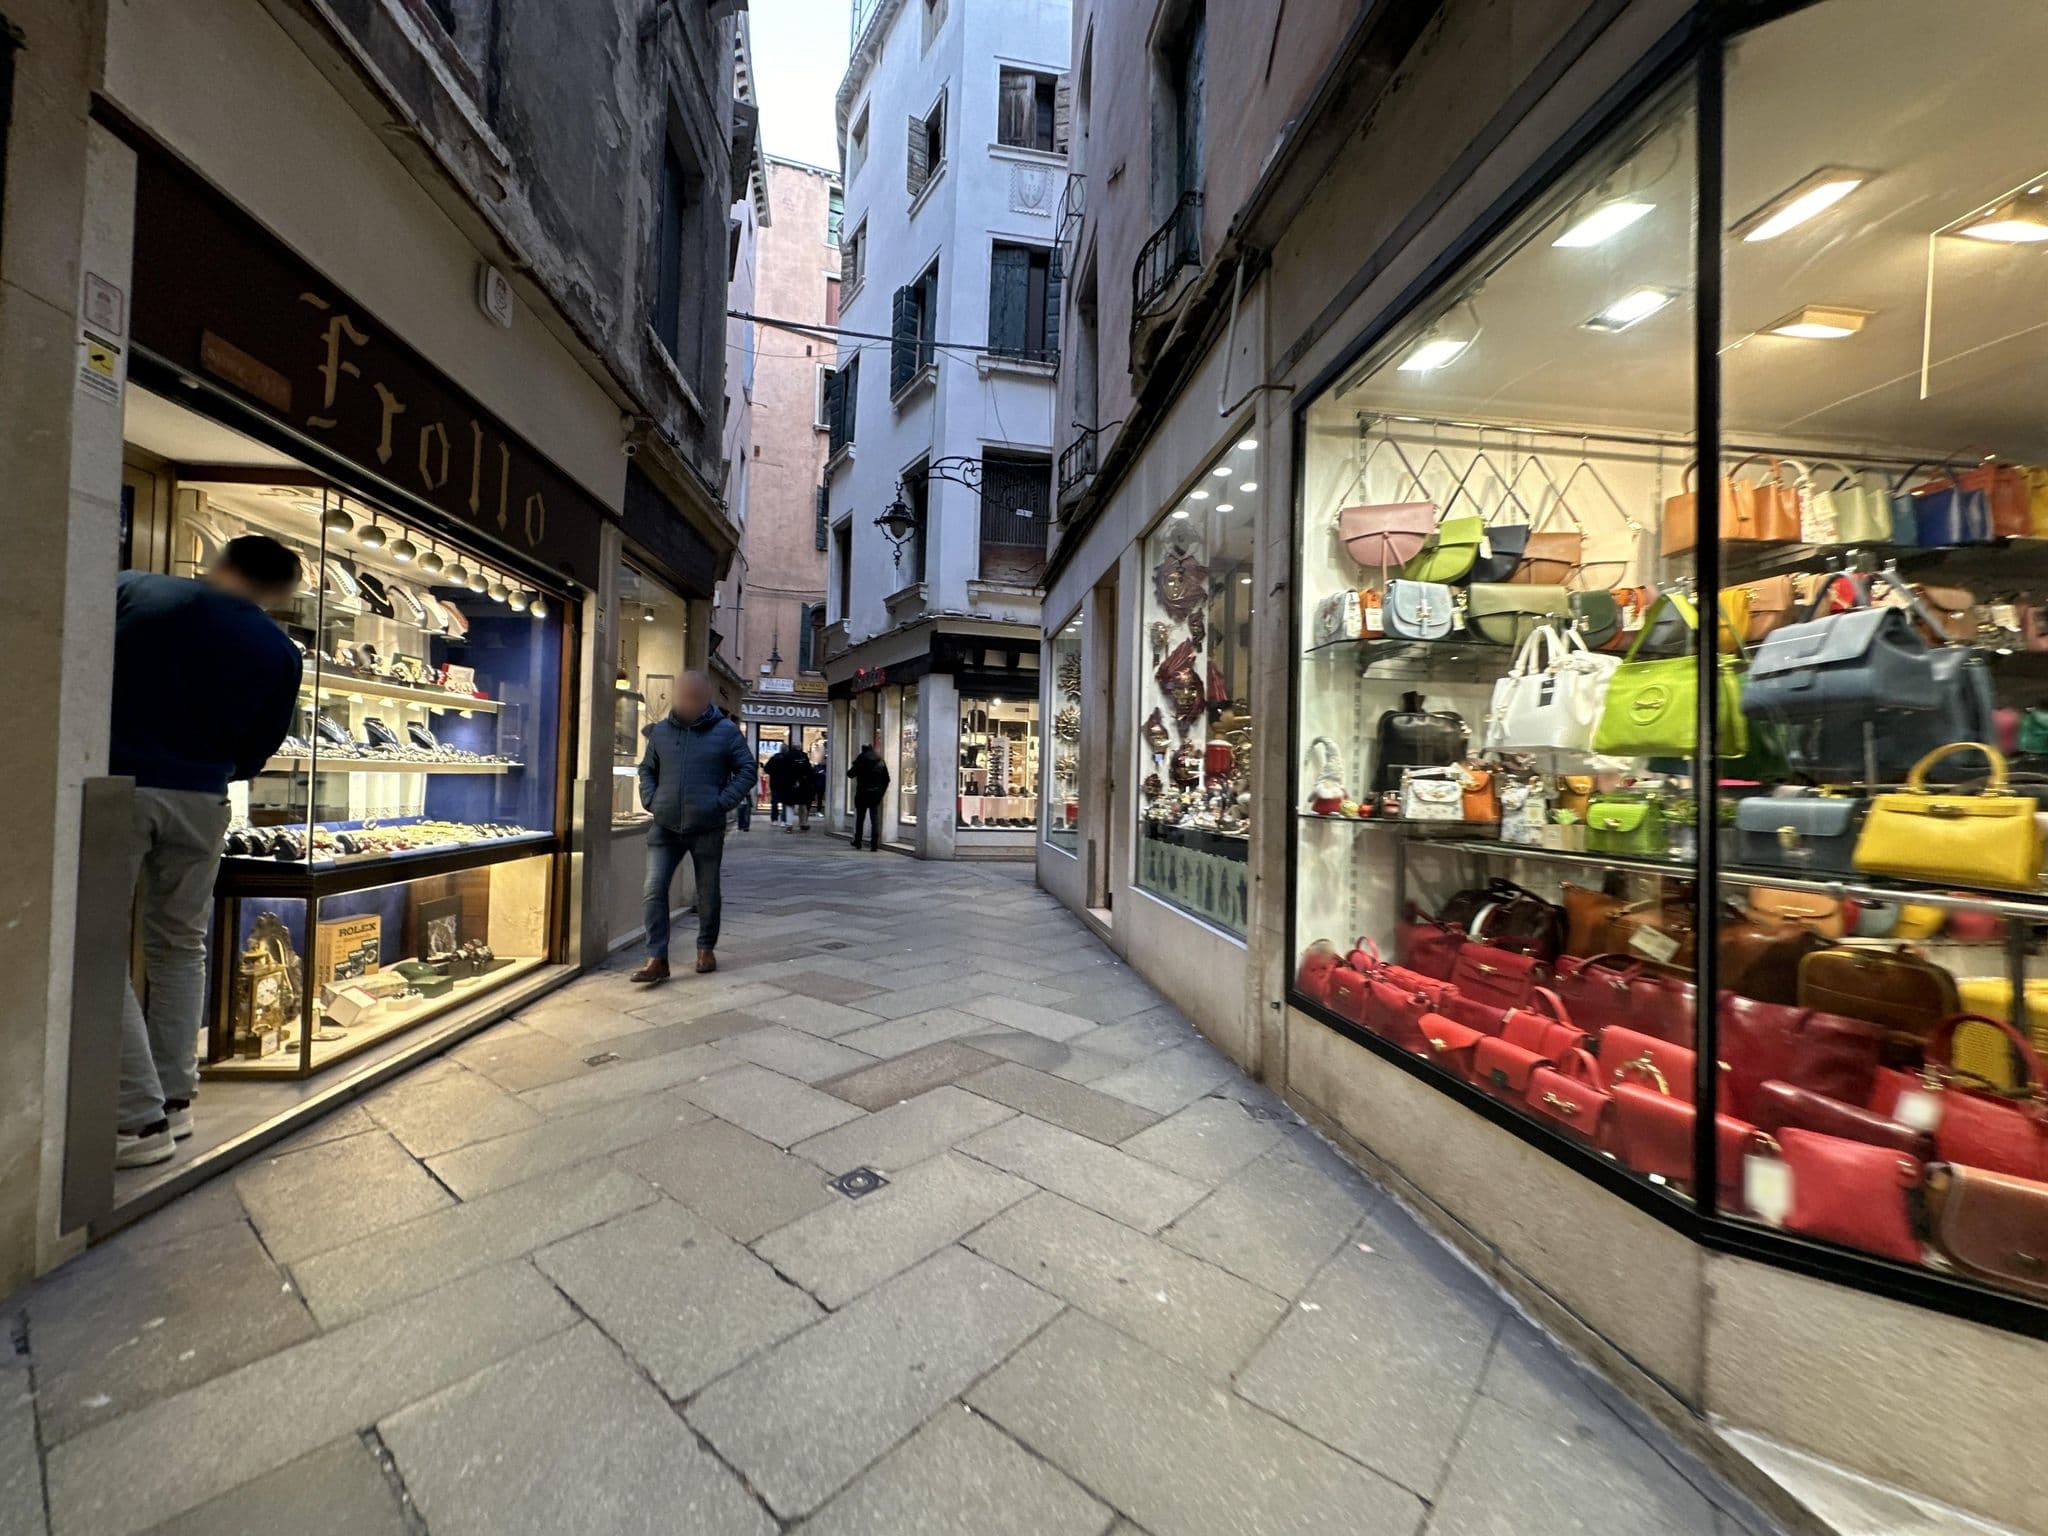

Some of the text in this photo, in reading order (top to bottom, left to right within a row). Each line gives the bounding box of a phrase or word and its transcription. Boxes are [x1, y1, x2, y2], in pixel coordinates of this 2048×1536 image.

[301, 292, 545, 547] Frollo
[741, 704, 820, 718] ALZEDONIA
[339, 923, 376, 937] ROLEX
